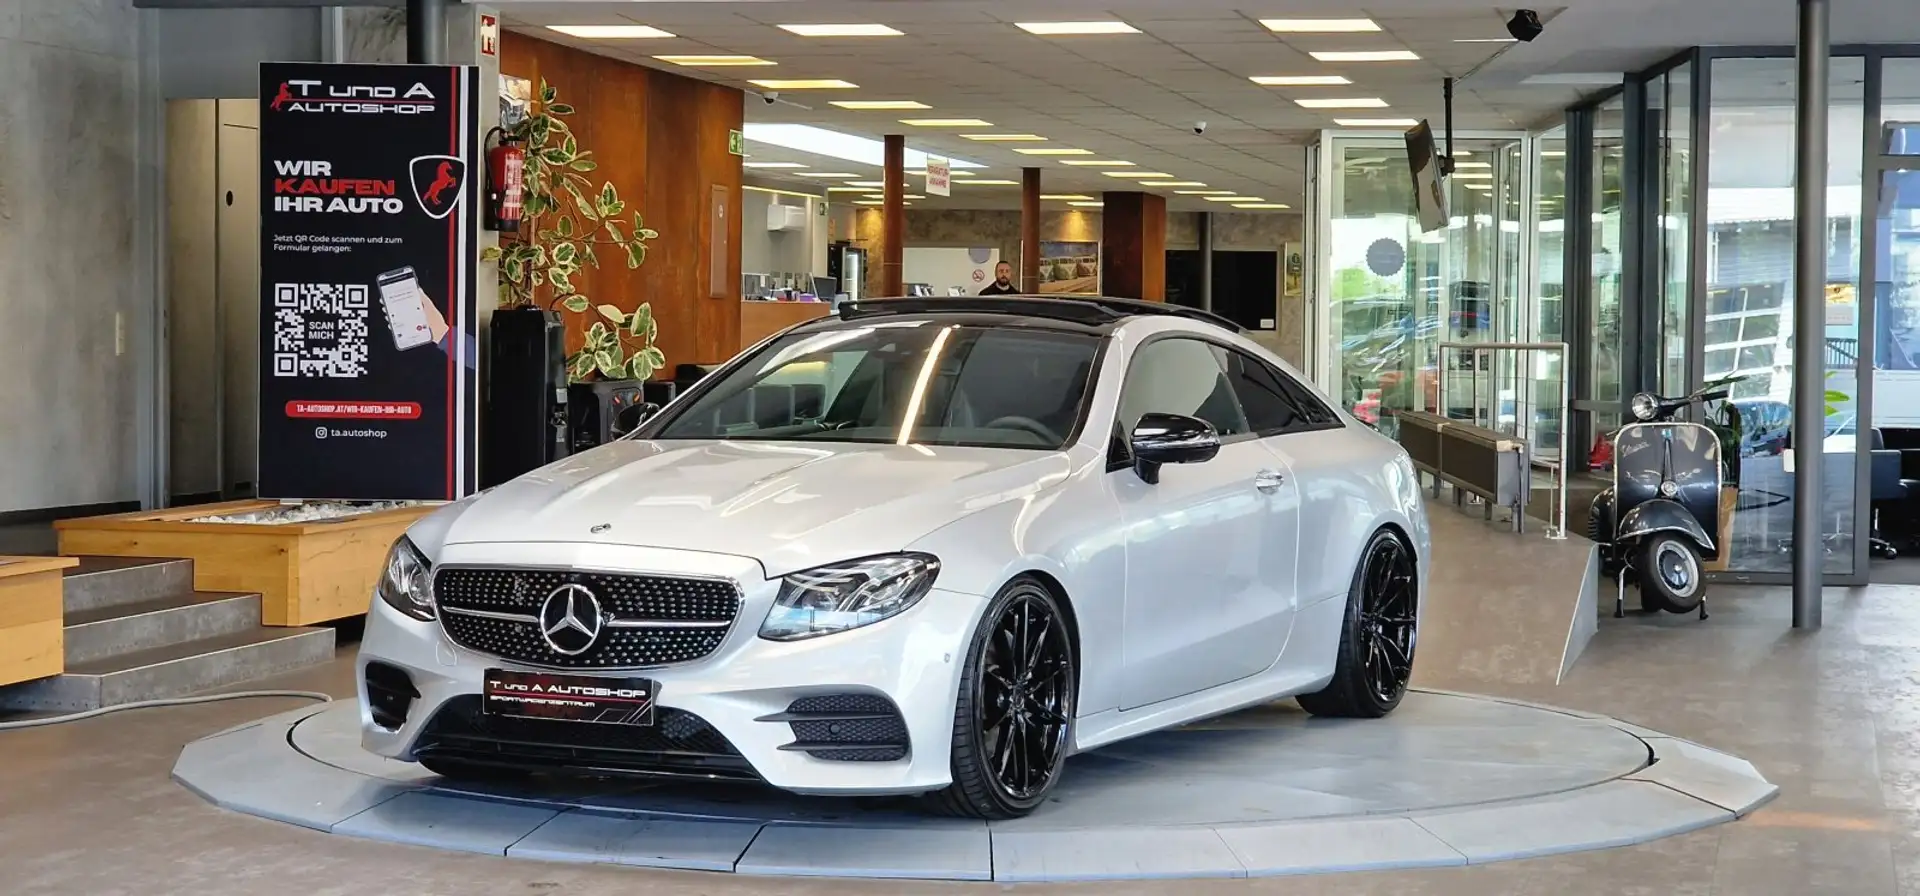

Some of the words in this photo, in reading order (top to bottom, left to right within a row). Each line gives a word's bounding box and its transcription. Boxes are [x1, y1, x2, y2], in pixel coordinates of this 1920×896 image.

[288, 80, 322, 96] T
[403, 82, 435, 98] A
[288, 102, 436, 114] AUTOSHOP
[274, 160, 331, 176] WIR
[274, 178, 395, 195] KAUFEN
[274, 196, 322, 212] IHR
[326, 198, 404, 214] AUTO
[273, 234, 293, 243] Jetzt
[294, 234, 308, 244] QR
[308, 234, 330, 243] Code
[331, 236, 365, 244] scannen
[367, 236, 383, 244] und
[273, 243, 310, 251] Formular
[311, 244, 352, 253] gelangen:
[308, 321, 334, 330] SCAN
[308, 331, 334, 340] MICH
[330, 428, 388, 439] ta.autoshop
[489, 680, 501, 689] T
[532, 683, 543, 692] A
[547, 684, 646, 698] AUTOSHOP
